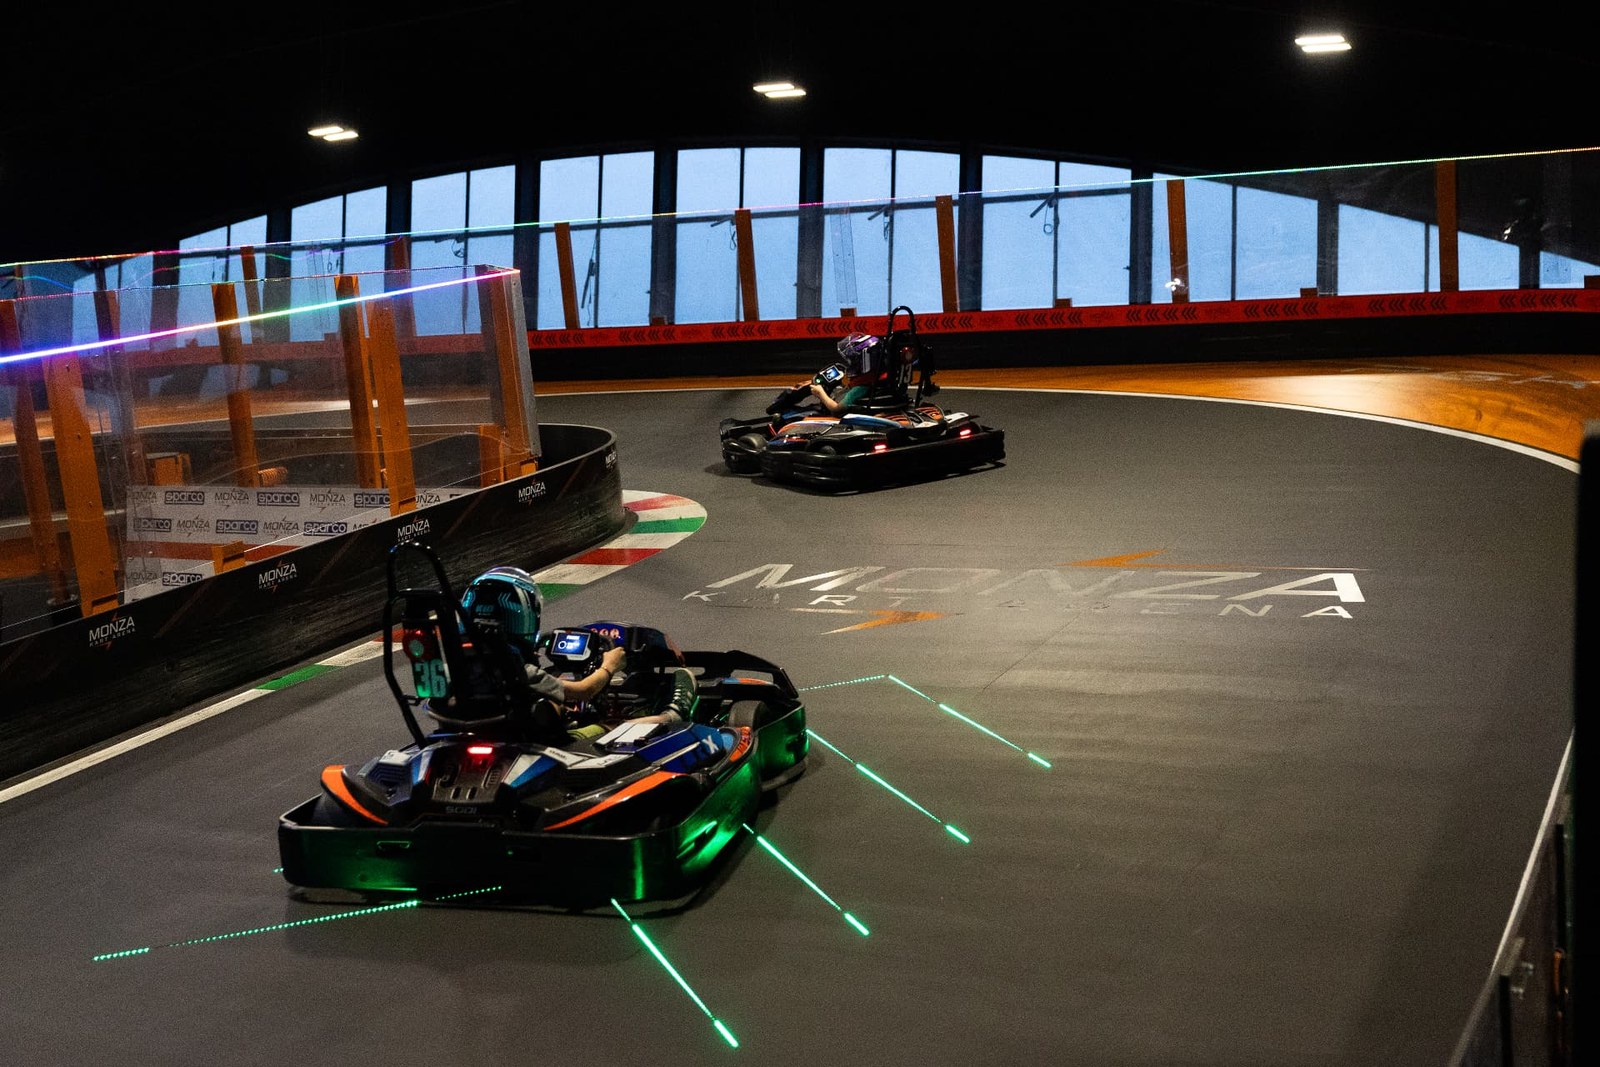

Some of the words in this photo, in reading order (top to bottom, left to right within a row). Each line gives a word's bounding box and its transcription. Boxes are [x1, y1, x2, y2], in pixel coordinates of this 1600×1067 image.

[165, 491, 204, 505] sparco
[214, 492, 249, 501] MONZA
[257, 492, 300, 506] sparco
[309, 493, 346, 503] MONZA
[354, 493, 390, 508] sparc
[518, 481, 546, 498] MONZA
[177, 520, 210, 529] MONZA
[216, 520, 258, 534] sparco
[263, 521, 300, 531] MONZA
[304, 522, 348, 536] sparco
[397, 519, 430, 538] MONZA
[258, 563, 297, 585] MONZA
[704, 563, 1366, 603] MONZA
[88, 616, 136, 642] MONZA
[414, 658, 447, 698] 36
